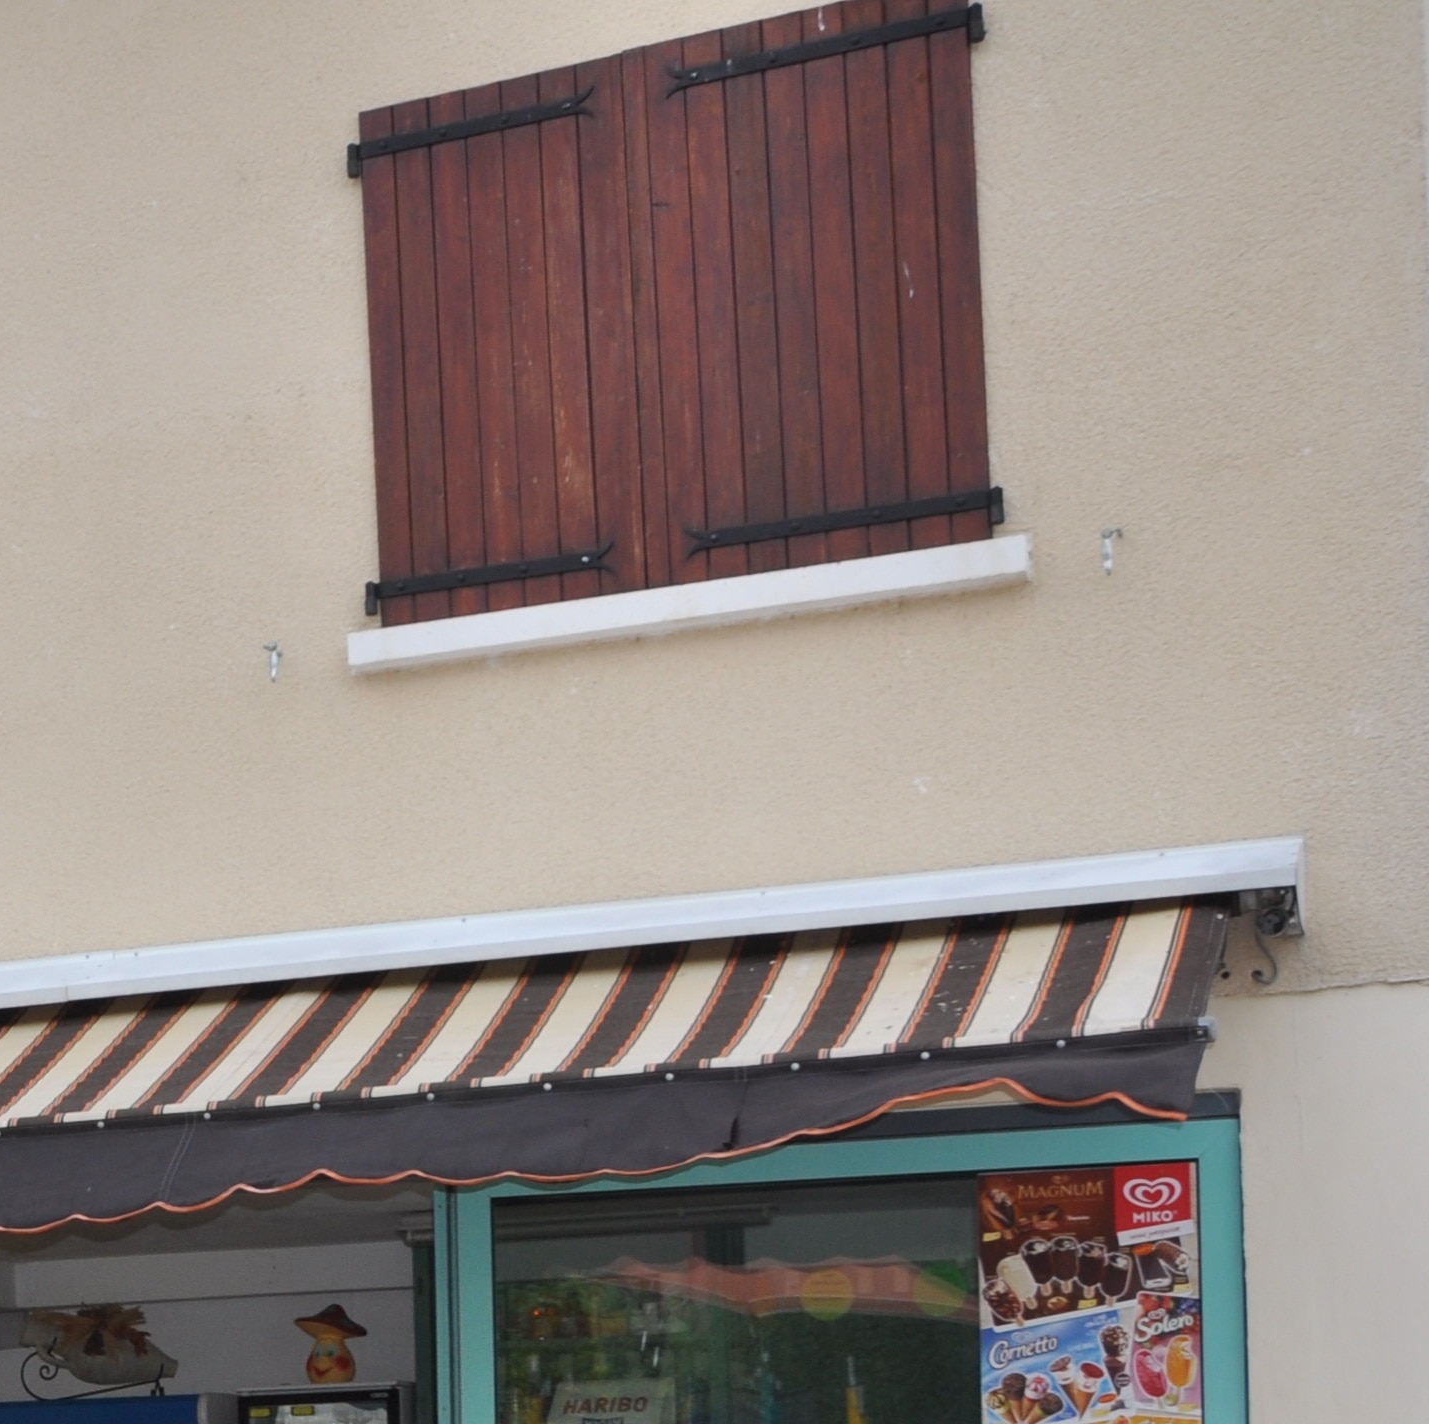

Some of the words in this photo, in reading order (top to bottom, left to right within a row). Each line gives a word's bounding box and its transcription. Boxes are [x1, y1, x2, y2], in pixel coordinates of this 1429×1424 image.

[1017, 1180, 1105, 1200] MAGNUM
[1132, 1209, 1173, 1224] MIKO
[1133, 1313, 1195, 1344] Solero
[988, 1335, 1059, 1370] Cornetto
[562, 1396, 649, 1415] HARIBO
